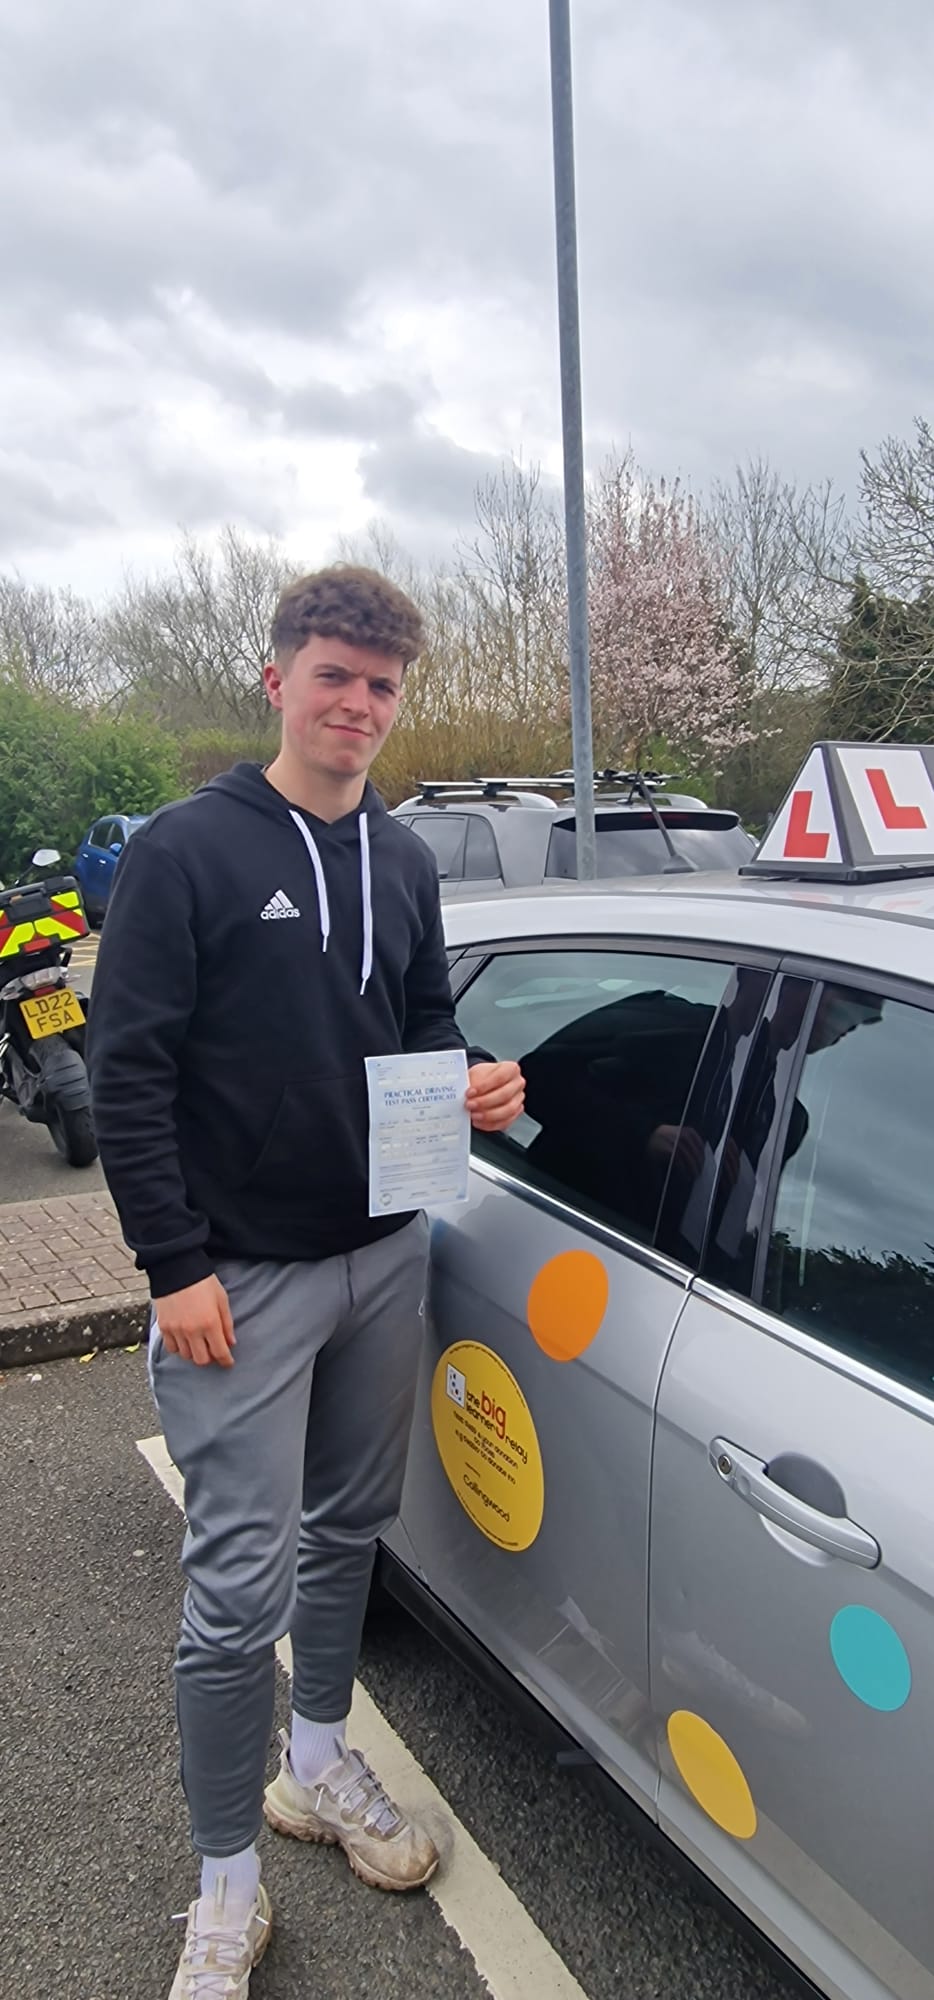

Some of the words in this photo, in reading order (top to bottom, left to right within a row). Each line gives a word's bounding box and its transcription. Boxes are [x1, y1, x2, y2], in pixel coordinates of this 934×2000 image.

[865, 768, 928, 829] L
[783, 790, 830, 859] L
[260, 908, 301, 920] adidas
[23, 991, 74, 1018] LD22
[36, 1010, 75, 1032] FSA
[384, 1087, 422, 1099] PRACTICAL
[424, 1086, 457, 1095] DRIVING
[385, 1099, 400, 1107] TEST
[401, 1097, 417, 1105] PASS
[418, 1093, 457, 1103] CERTIFICATE
[466, 1390, 481, 1408] the
[481, 1389, 506, 1440] big
[466, 1402, 495, 1431] learner
[505, 1435, 528, 1465] relay
[463, 1474, 510, 1522] Collingwood
